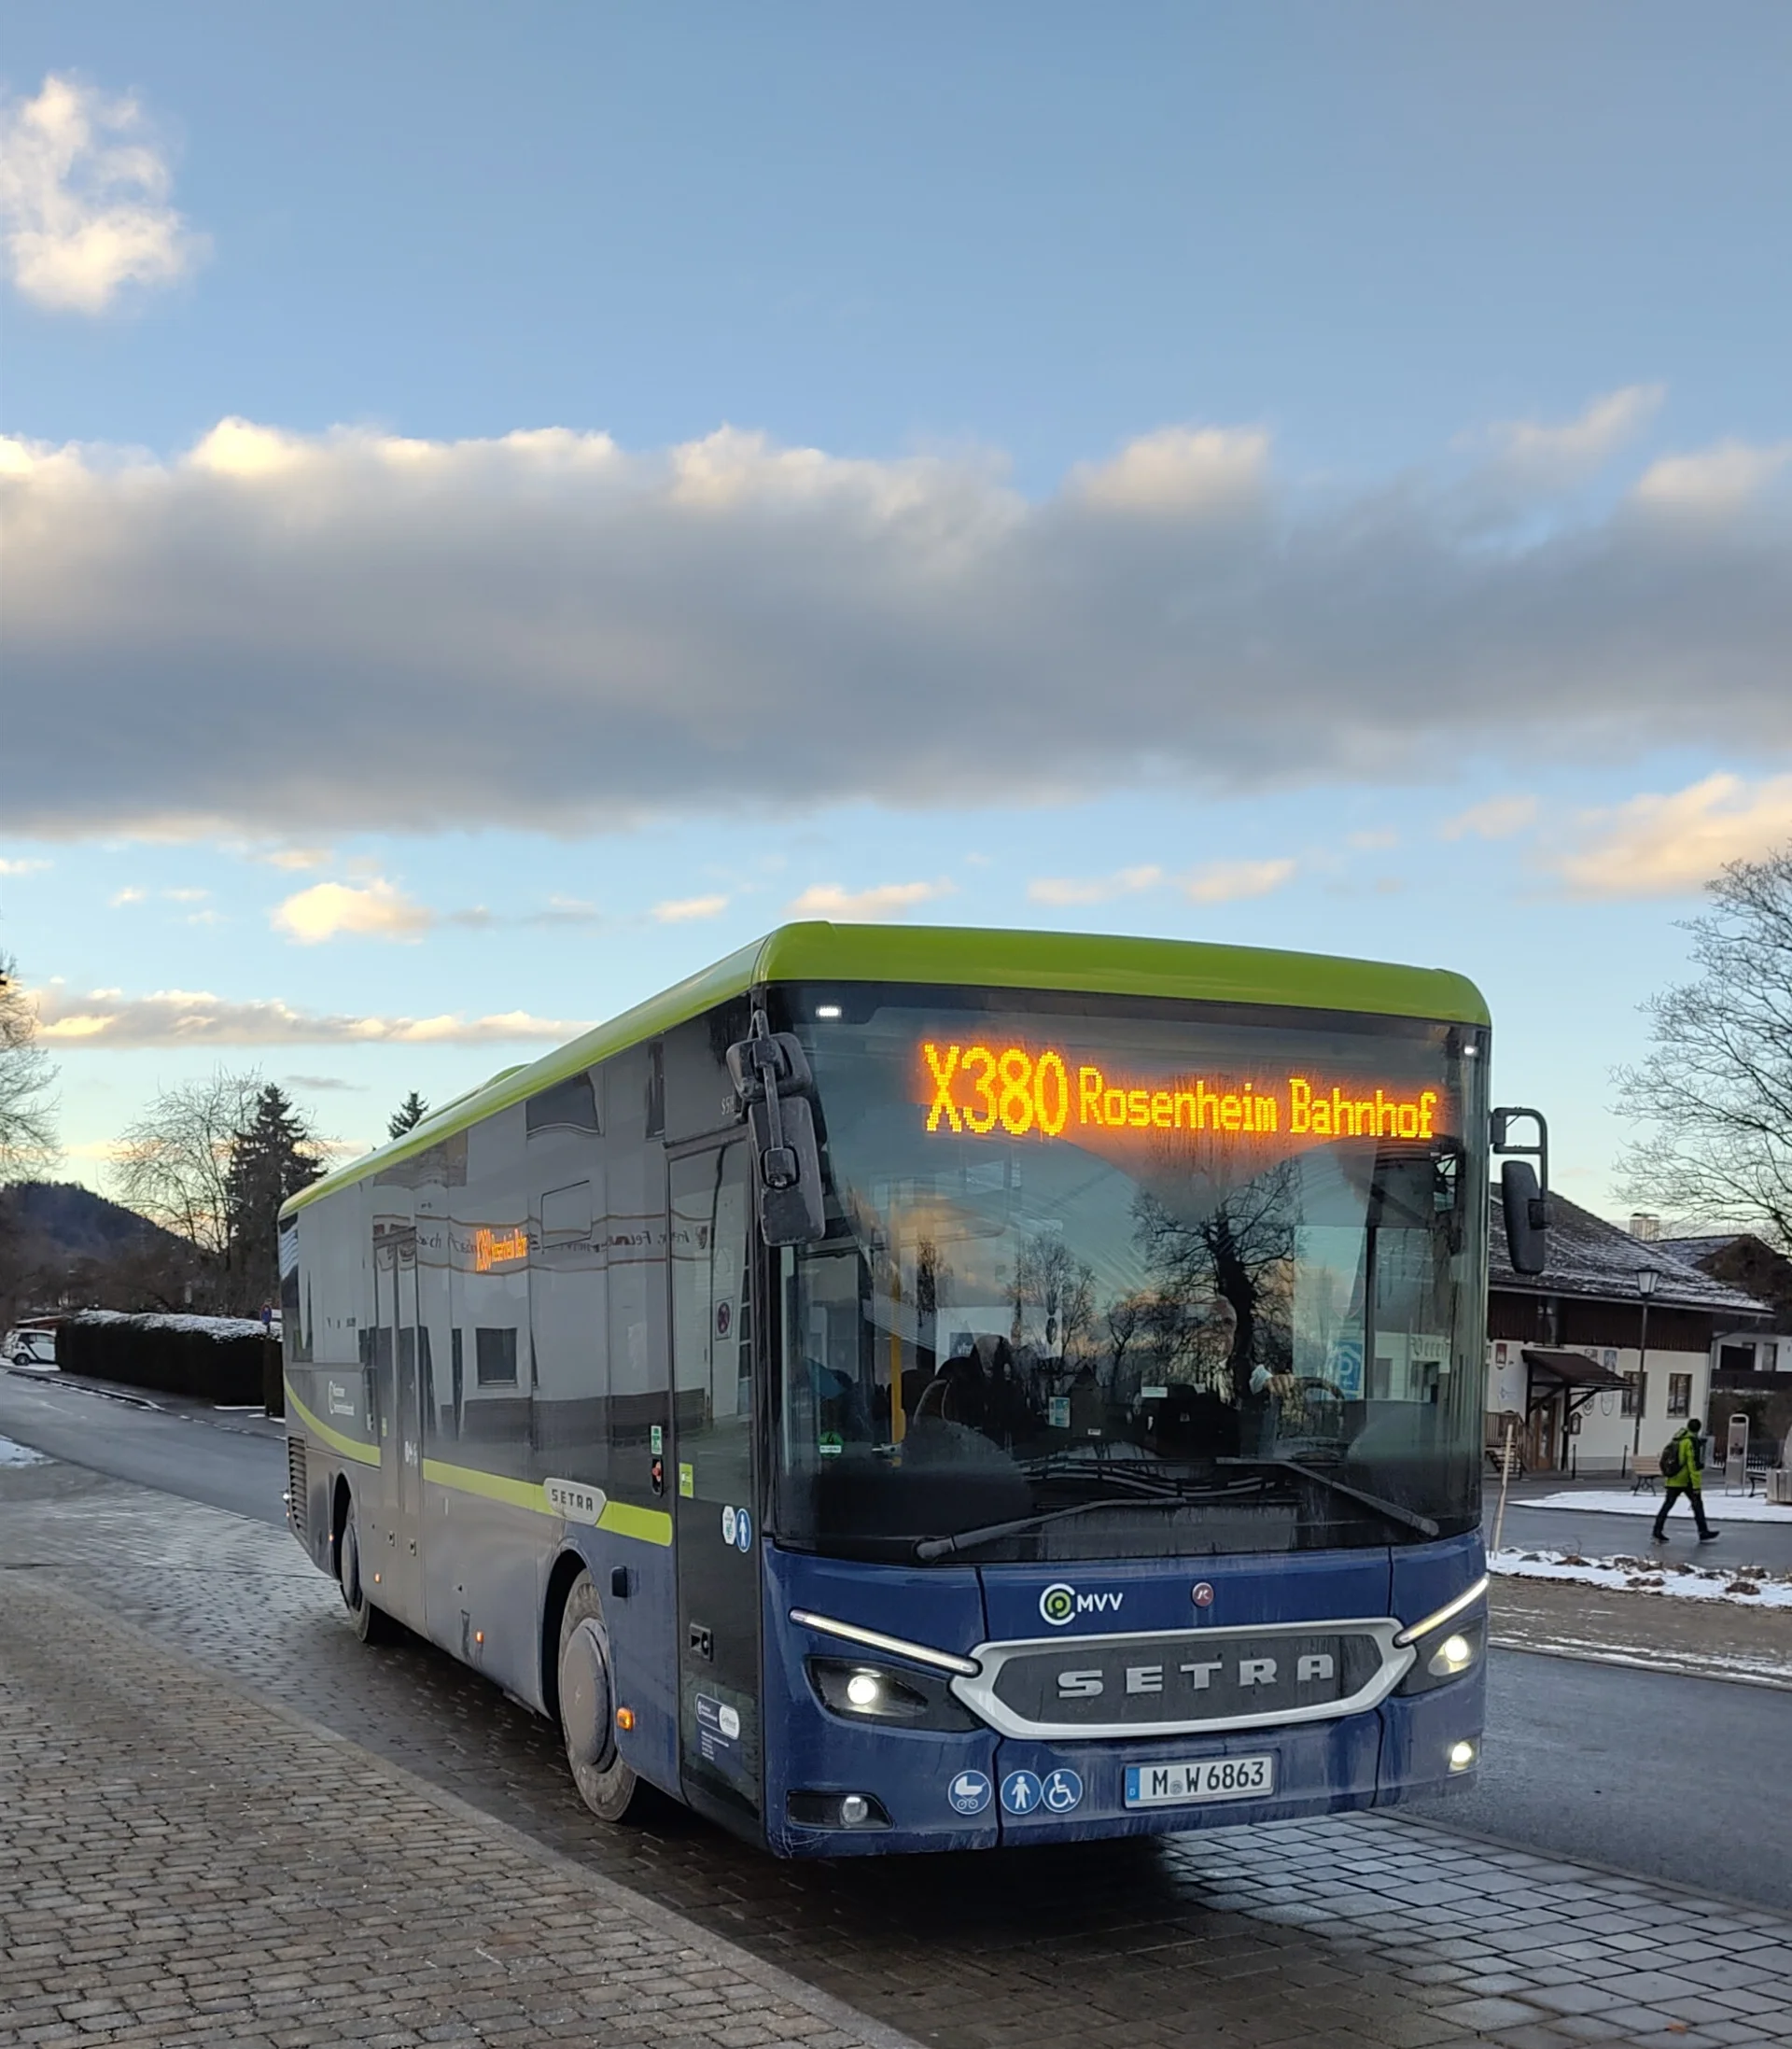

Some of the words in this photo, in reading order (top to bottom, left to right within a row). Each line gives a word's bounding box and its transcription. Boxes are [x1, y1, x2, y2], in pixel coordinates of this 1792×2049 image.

[924, 1044, 1068, 1137] X380
[1079, 1066, 1277, 1132] Rosenheim
[1289, 1078, 1437, 1139] Bahnhof
[551, 1488, 594, 1512] SETRA
[1076, 1592, 1124, 1612] MVV
[1057, 1654, 1335, 1698] SETRA
[1128, 1787, 1137, 1797] D
[1152, 1769, 1169, 1797] M
[1206, 1760, 1265, 1791] 6863
